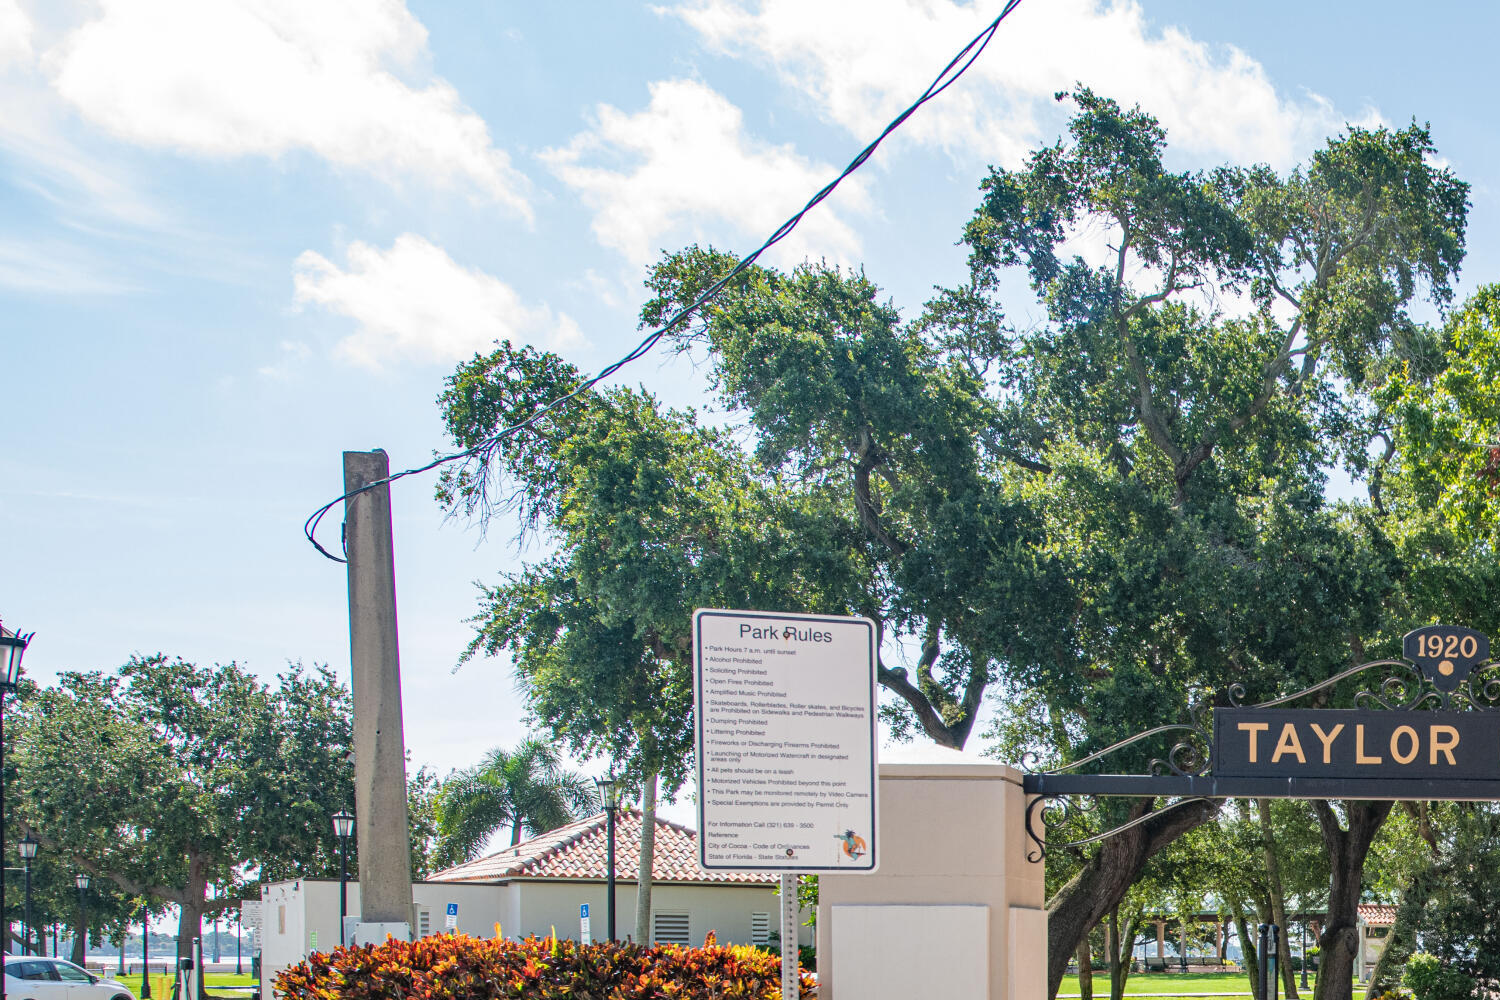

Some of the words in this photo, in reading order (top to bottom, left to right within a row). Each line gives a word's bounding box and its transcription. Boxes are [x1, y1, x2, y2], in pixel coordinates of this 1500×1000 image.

[740, 624, 778, 640] Park
[785, 627, 832, 642] Rules
[1417, 634, 1478, 658] 1920
[1237, 722, 1461, 766] TAYLOR
